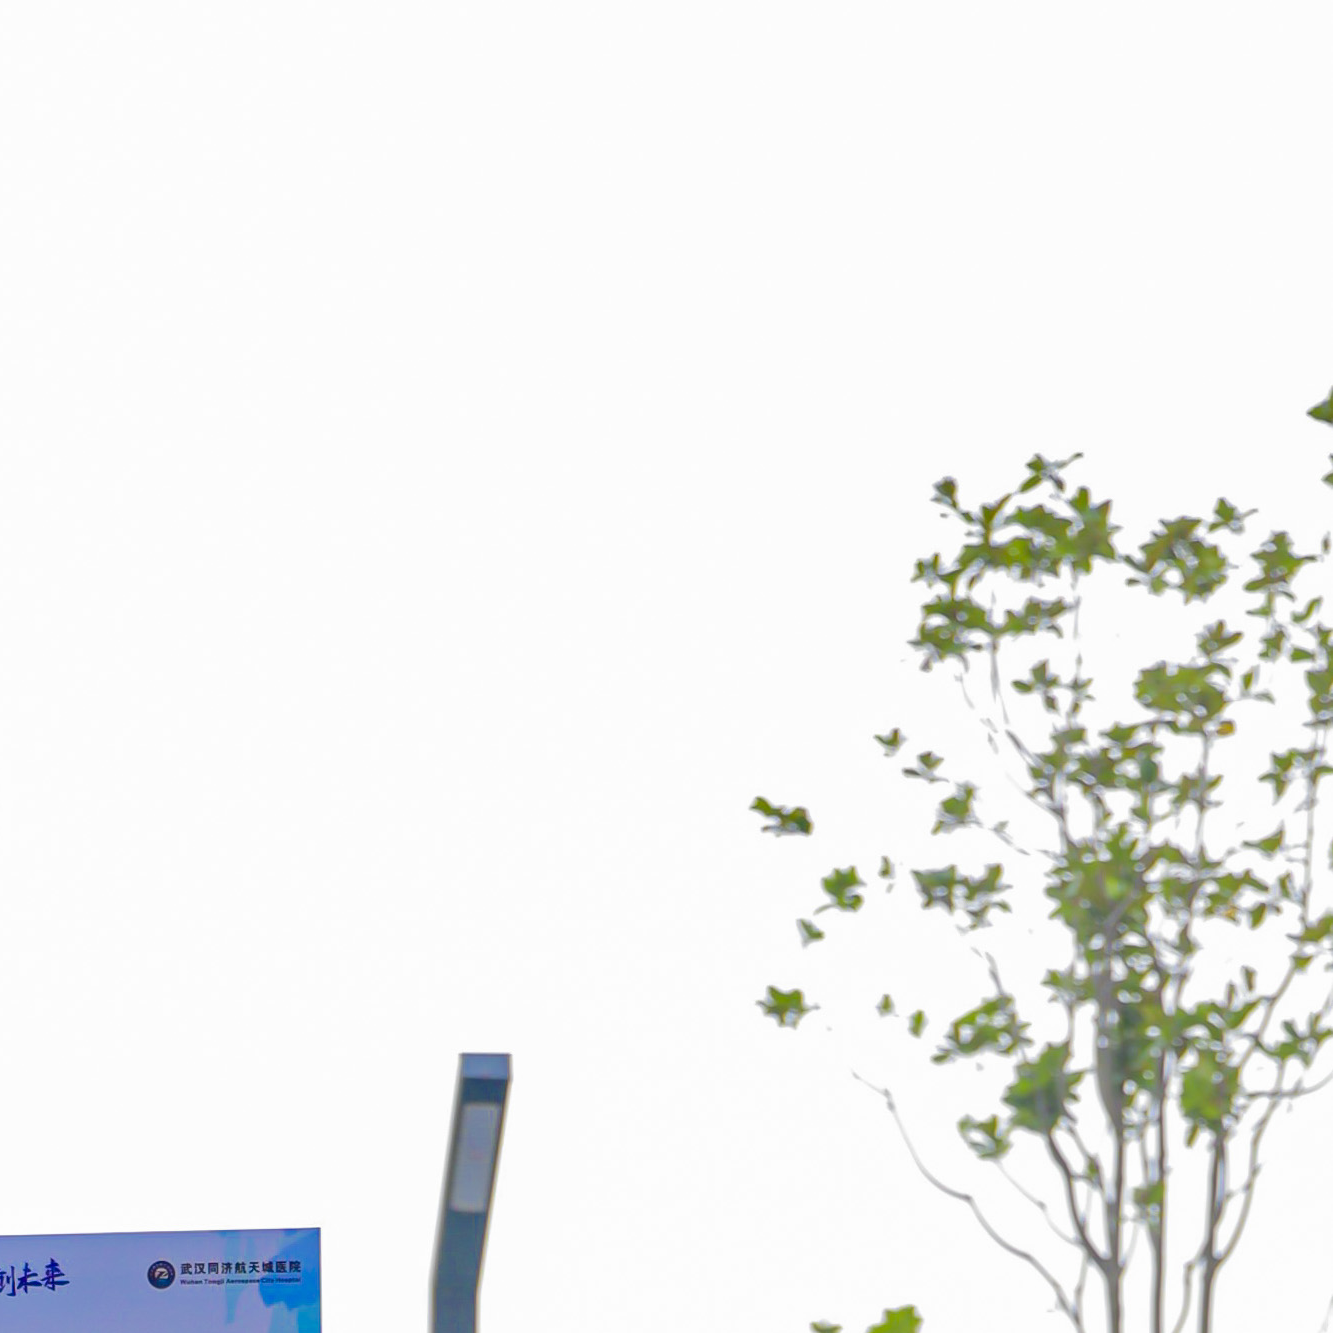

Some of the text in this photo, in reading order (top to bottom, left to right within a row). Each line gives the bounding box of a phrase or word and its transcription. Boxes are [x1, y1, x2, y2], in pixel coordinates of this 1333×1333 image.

[180, 1261, 302, 1275] 武汉同济航天城医院
